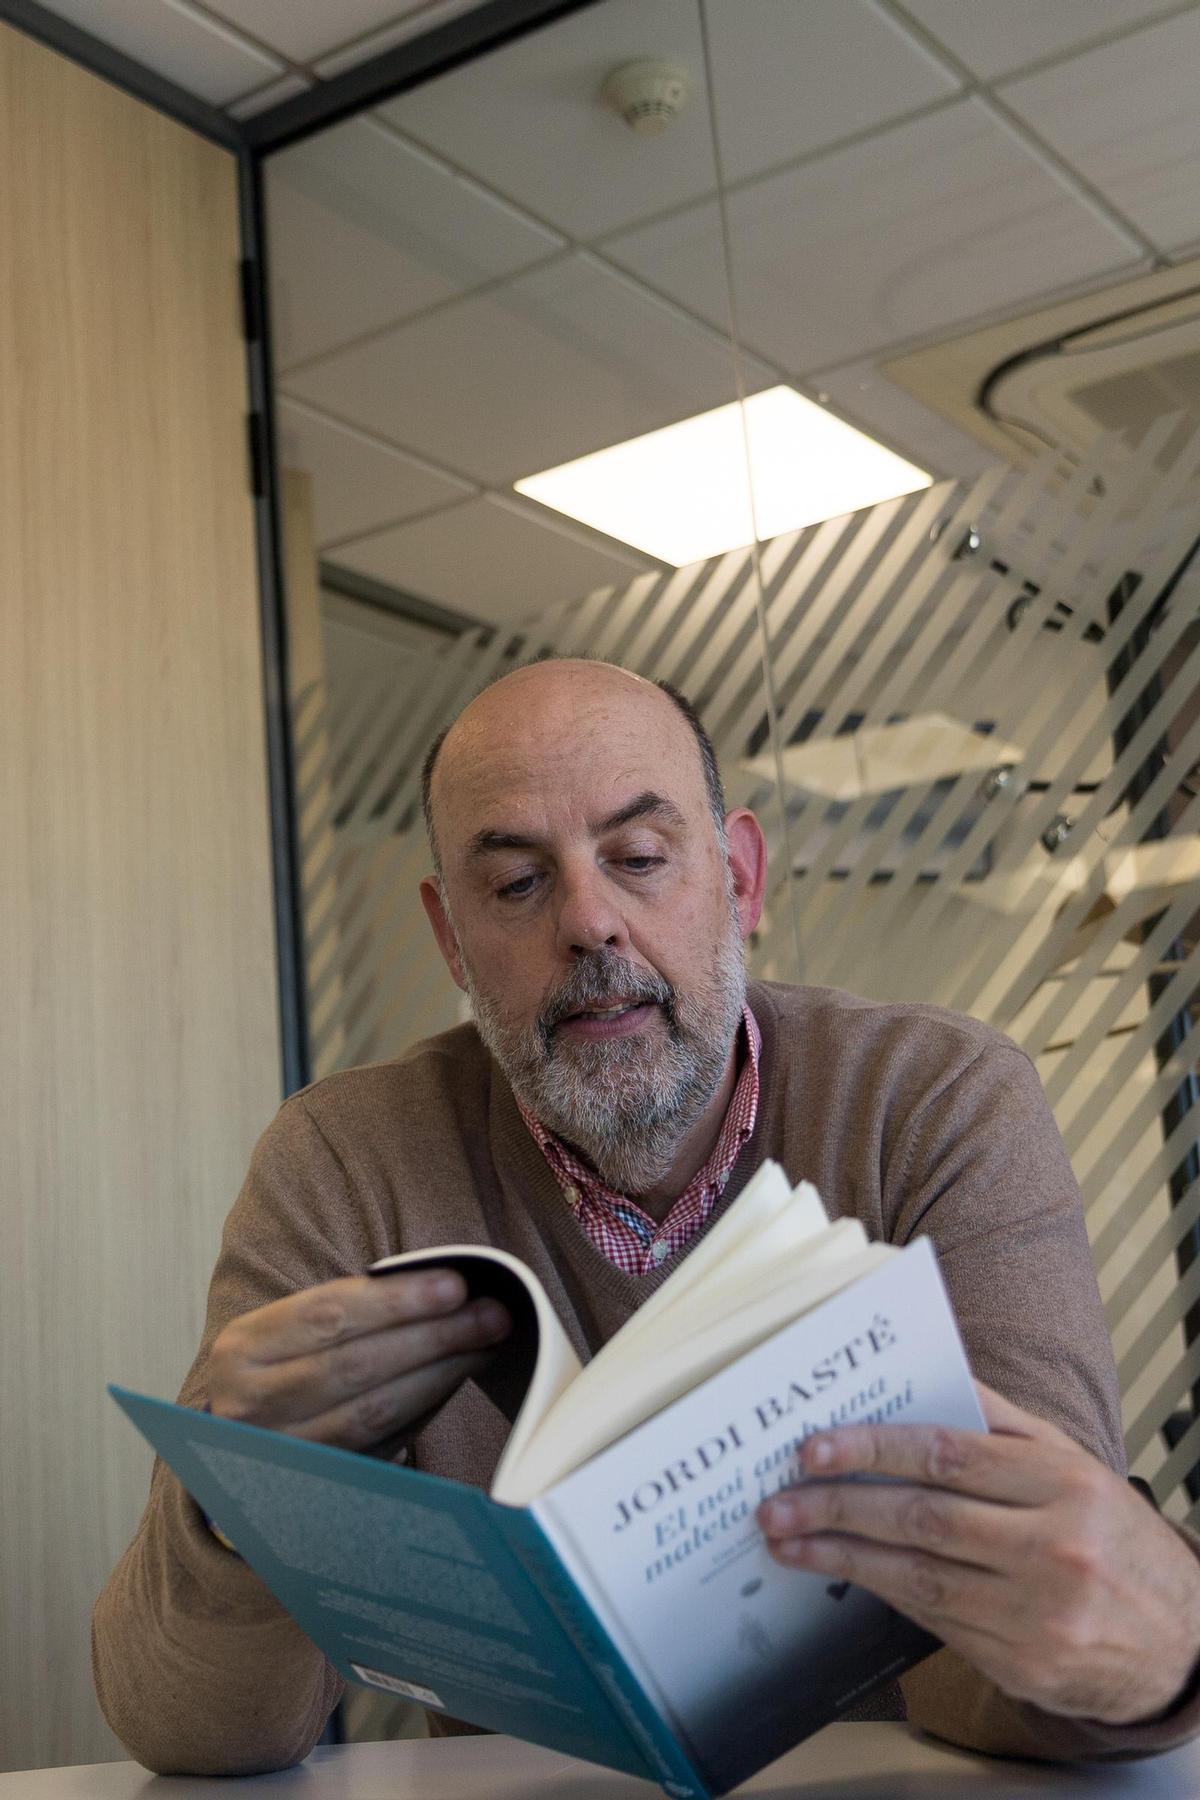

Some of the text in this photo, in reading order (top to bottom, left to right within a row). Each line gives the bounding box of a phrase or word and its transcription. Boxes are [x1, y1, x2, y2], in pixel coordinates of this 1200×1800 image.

[612, 1311, 897, 1533] JORDI BASTÉ
[644, 1499, 749, 1584] maleta
[654, 1505, 688, 1547] El
[697, 1465, 743, 1518] noi
